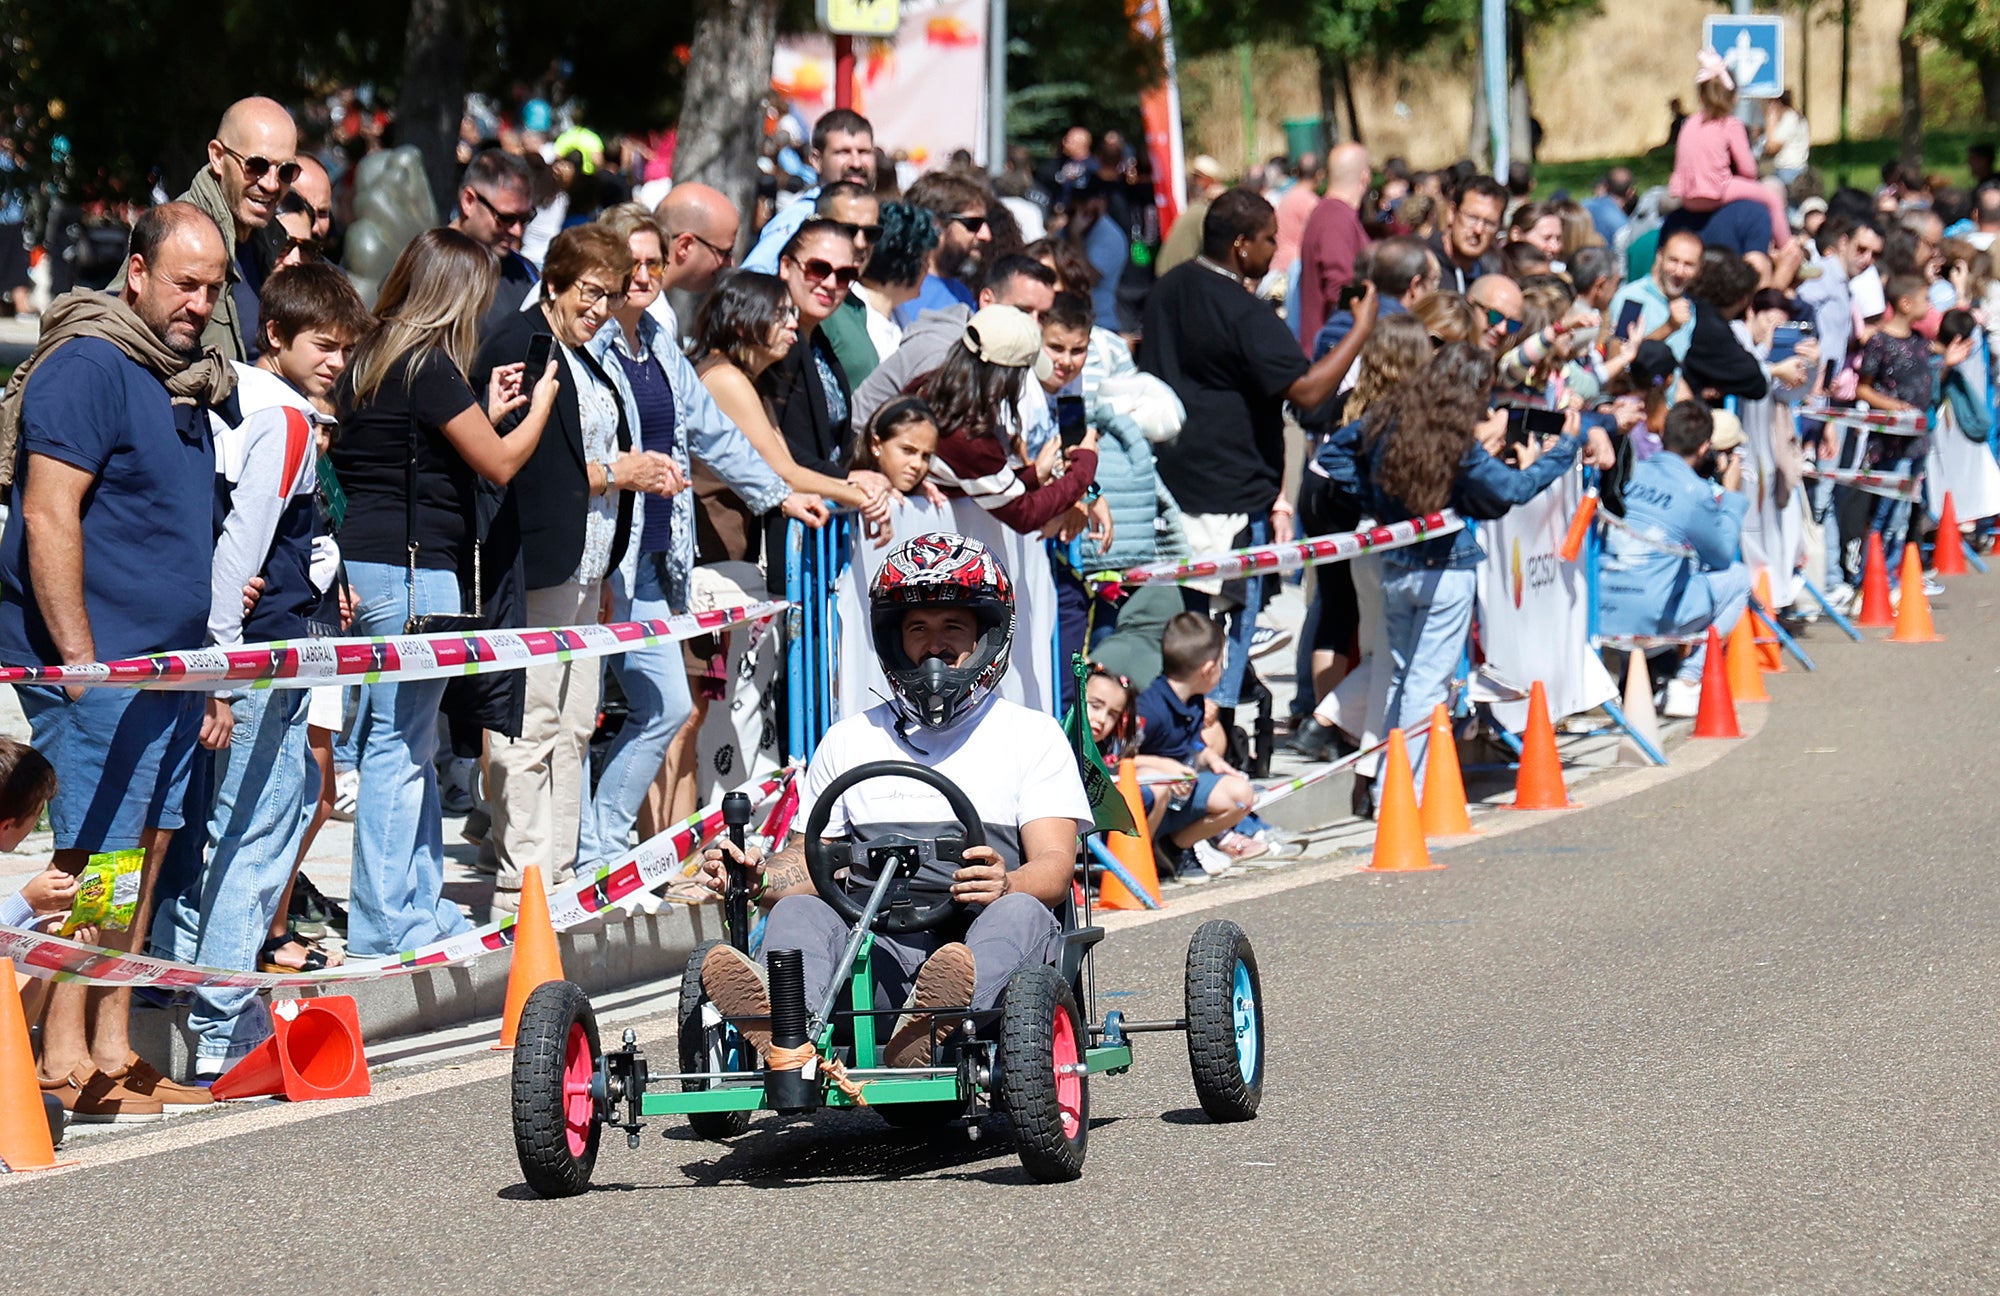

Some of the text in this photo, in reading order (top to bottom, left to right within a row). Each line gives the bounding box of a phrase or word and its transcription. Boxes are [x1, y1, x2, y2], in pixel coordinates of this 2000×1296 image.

[183, 652, 225, 669] LABORAL
[300, 645, 333, 662] LABORAL
[643, 852, 675, 880] LABORAL
